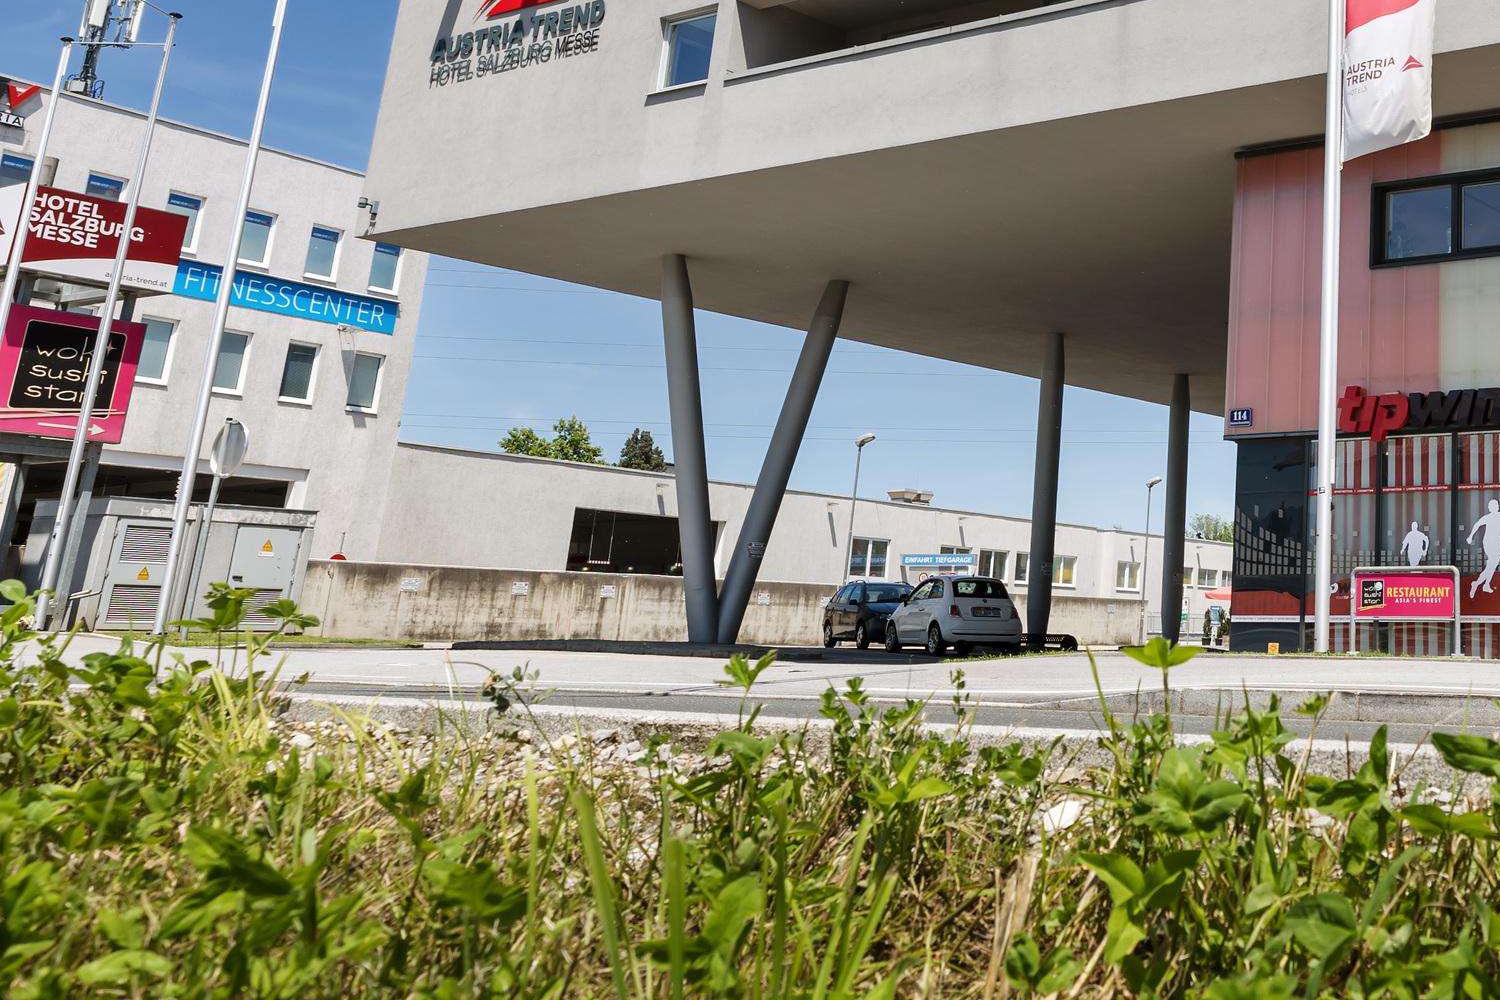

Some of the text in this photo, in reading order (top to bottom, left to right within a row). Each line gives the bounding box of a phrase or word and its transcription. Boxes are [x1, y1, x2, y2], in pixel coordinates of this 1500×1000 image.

[431, 0, 605, 66] AUSTRIA TREND
[430, 29, 600, 87] HOTEL SALZBURG MESSE
[1347, 57, 1395, 76] AUSTRIA
[1347, 70, 1382, 86] TREND
[34, 192, 103, 219] HOTEL
[184, 267, 385, 326] FITNESSCENTER
[1233, 410, 1247, 421] 114
[904, 556, 973, 564] EINFAHRT TIEFGARAGE
[1387, 587, 1450, 598] RESTAURANT
